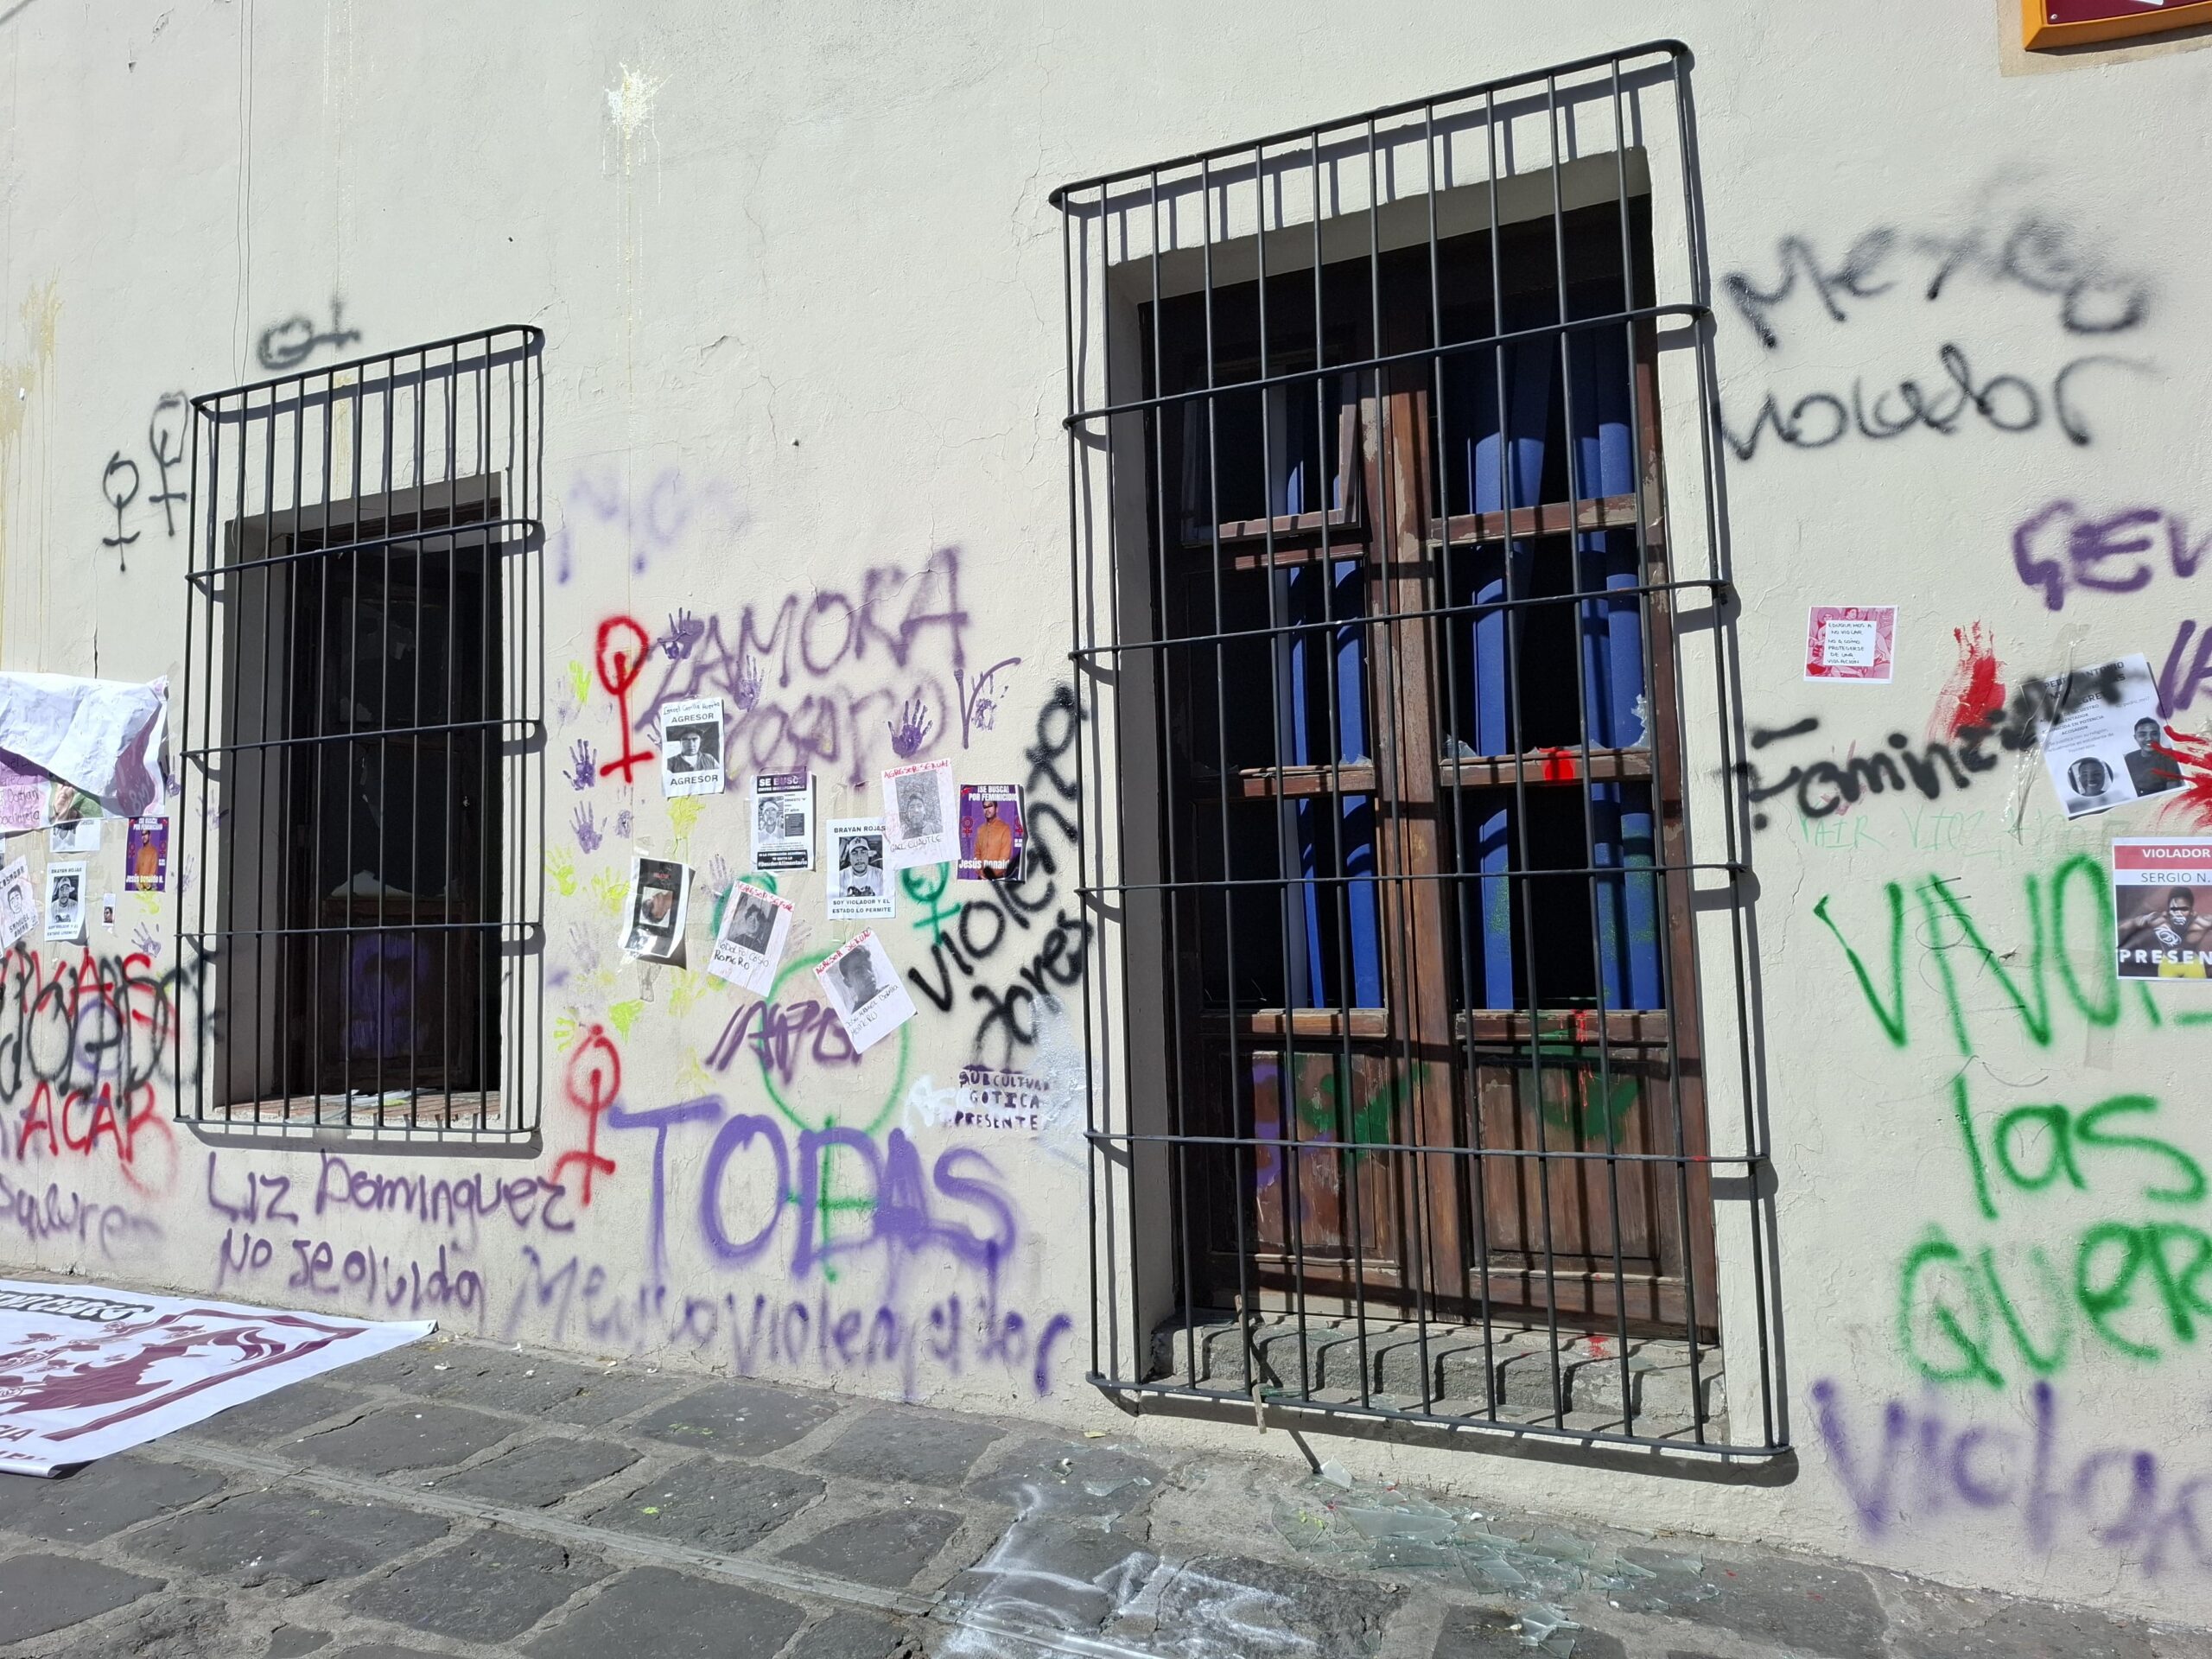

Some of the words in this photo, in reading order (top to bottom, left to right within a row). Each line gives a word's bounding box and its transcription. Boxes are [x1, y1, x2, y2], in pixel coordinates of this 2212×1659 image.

[671, 713, 715, 723] AGRESOR
[671, 774, 719, 785] AGRESOR
[760, 778, 772, 786] SE
[2142, 849, 2211, 858] VIOLADOR
[958, 857, 982, 869] Jesús
[2141, 873, 2192, 883] SERGIO
[2196, 873, 2211, 883] N.
[9, 913, 29, 933] SAMUEL
[969, 1090, 1039, 1109] GOTICA
[955, 1110, 1038, 1130] PRESENTE
[17, 1080, 176, 1198] ACAB
[607, 1094, 1018, 1281] TODAS
